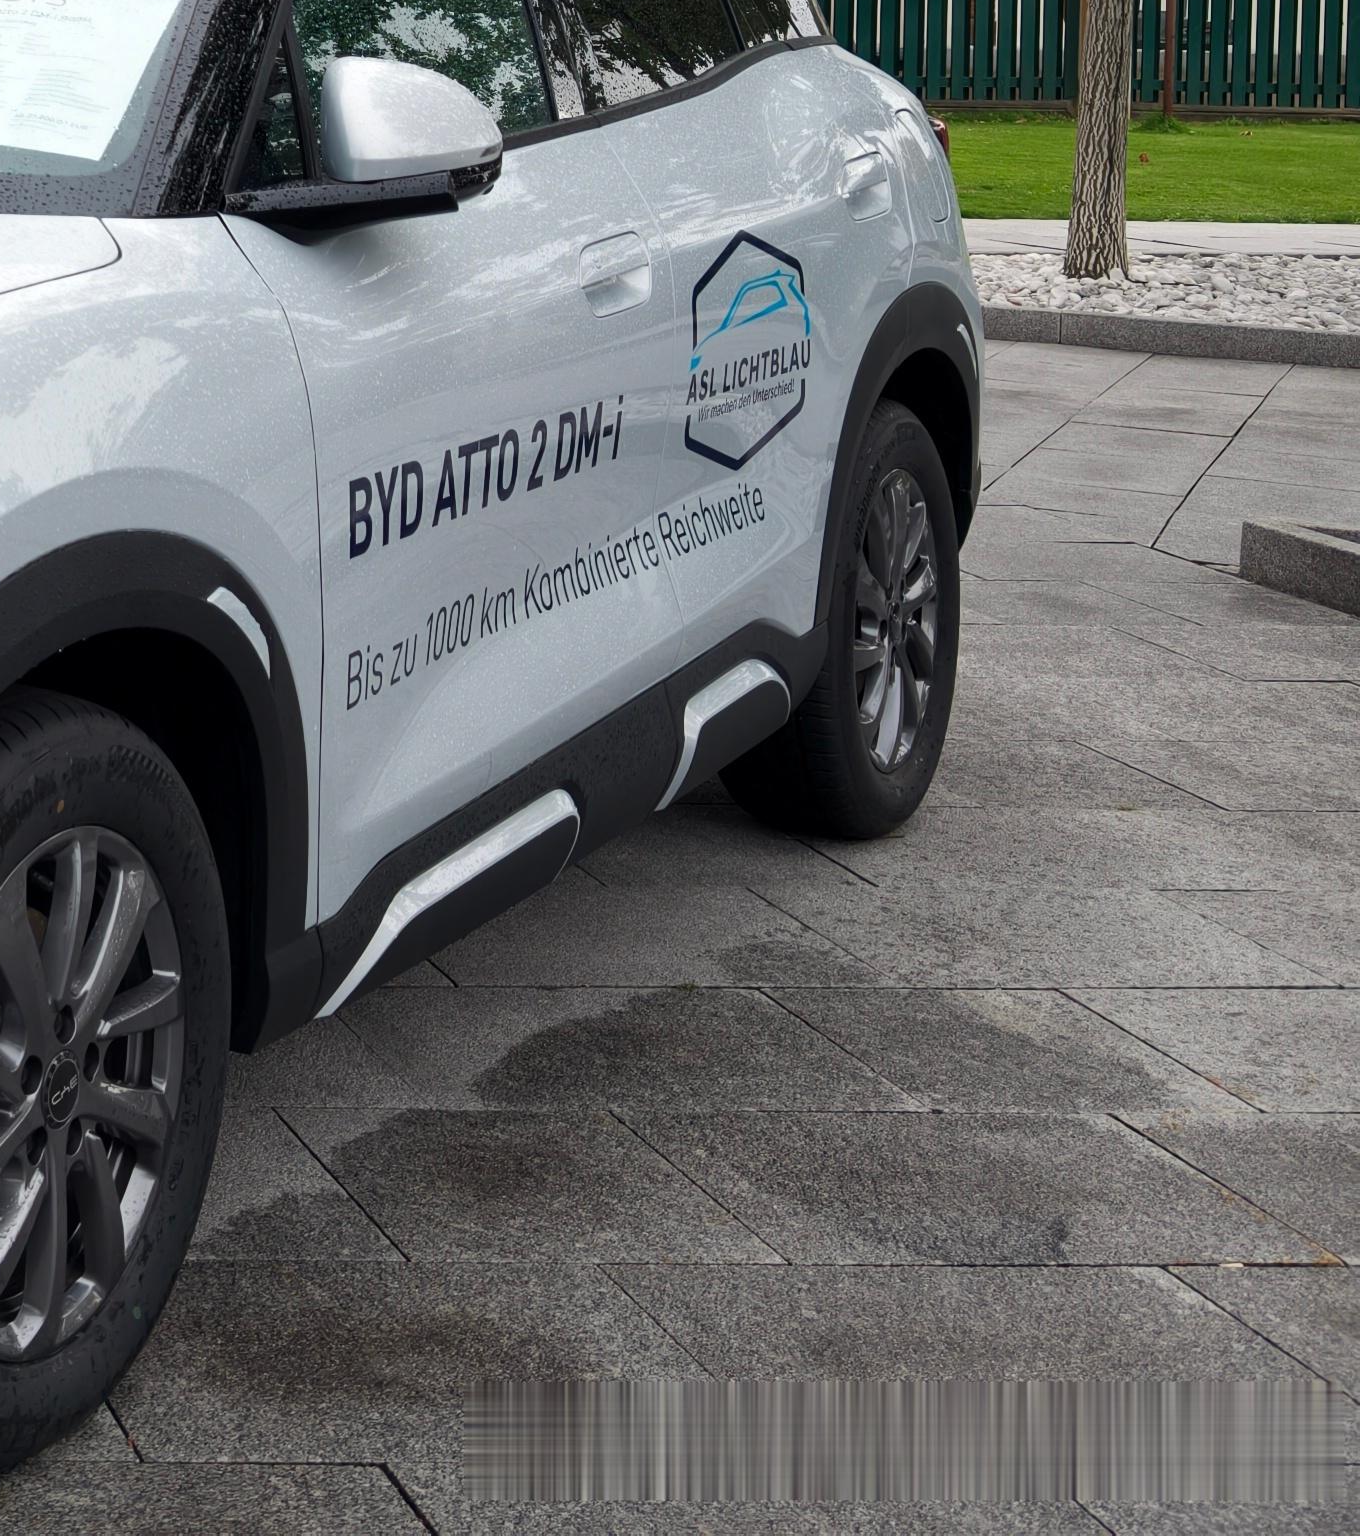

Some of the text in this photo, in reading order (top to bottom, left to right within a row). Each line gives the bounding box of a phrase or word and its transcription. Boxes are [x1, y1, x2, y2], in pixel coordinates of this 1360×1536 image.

[685, 338, 811, 406] ASL LICHTBLAU
[738, 392, 752, 409] den
[752, 378, 795, 403] Unterschied!
[348, 394, 625, 560] BYD ATTO 2 DM-i
[346, 482, 766, 712] Bis zu 1000 km Kombinierte Reichweite
